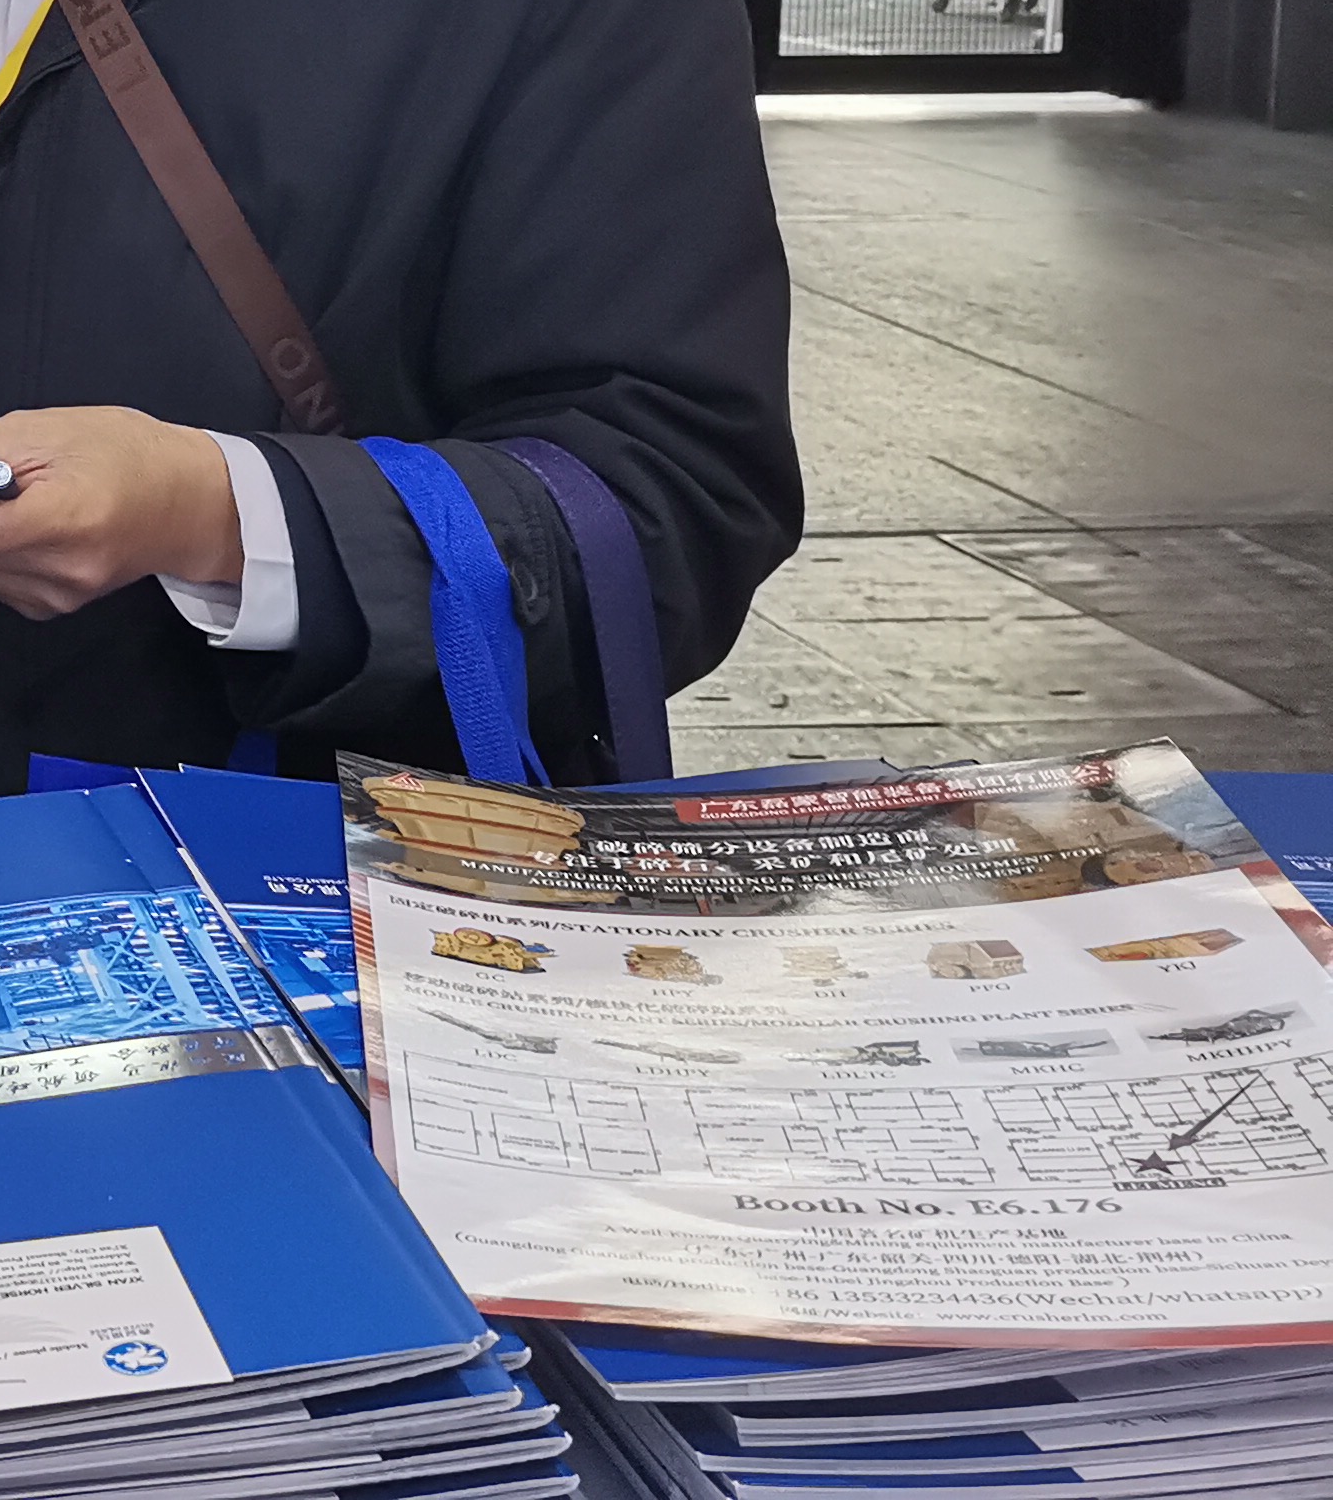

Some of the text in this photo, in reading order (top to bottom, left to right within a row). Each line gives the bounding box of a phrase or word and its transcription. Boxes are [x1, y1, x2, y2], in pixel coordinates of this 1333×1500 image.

[594, 828, 932, 858] 破碎筛分设备制造商
[460, 858, 630, 885] MANUFACTURER
[664, 875, 776, 887] CRUSHING
[731, 925, 859, 938] CRUSHER
[733, 1193, 1126, 1216] Booth No. E6.176
[1158, 1234, 1204, 1245] base
[1230, 1231, 1293, 1243] China
[0, 1285, 49, 1299] HORSE
[934, 1309, 1170, 1324] www.crusherlm.com
